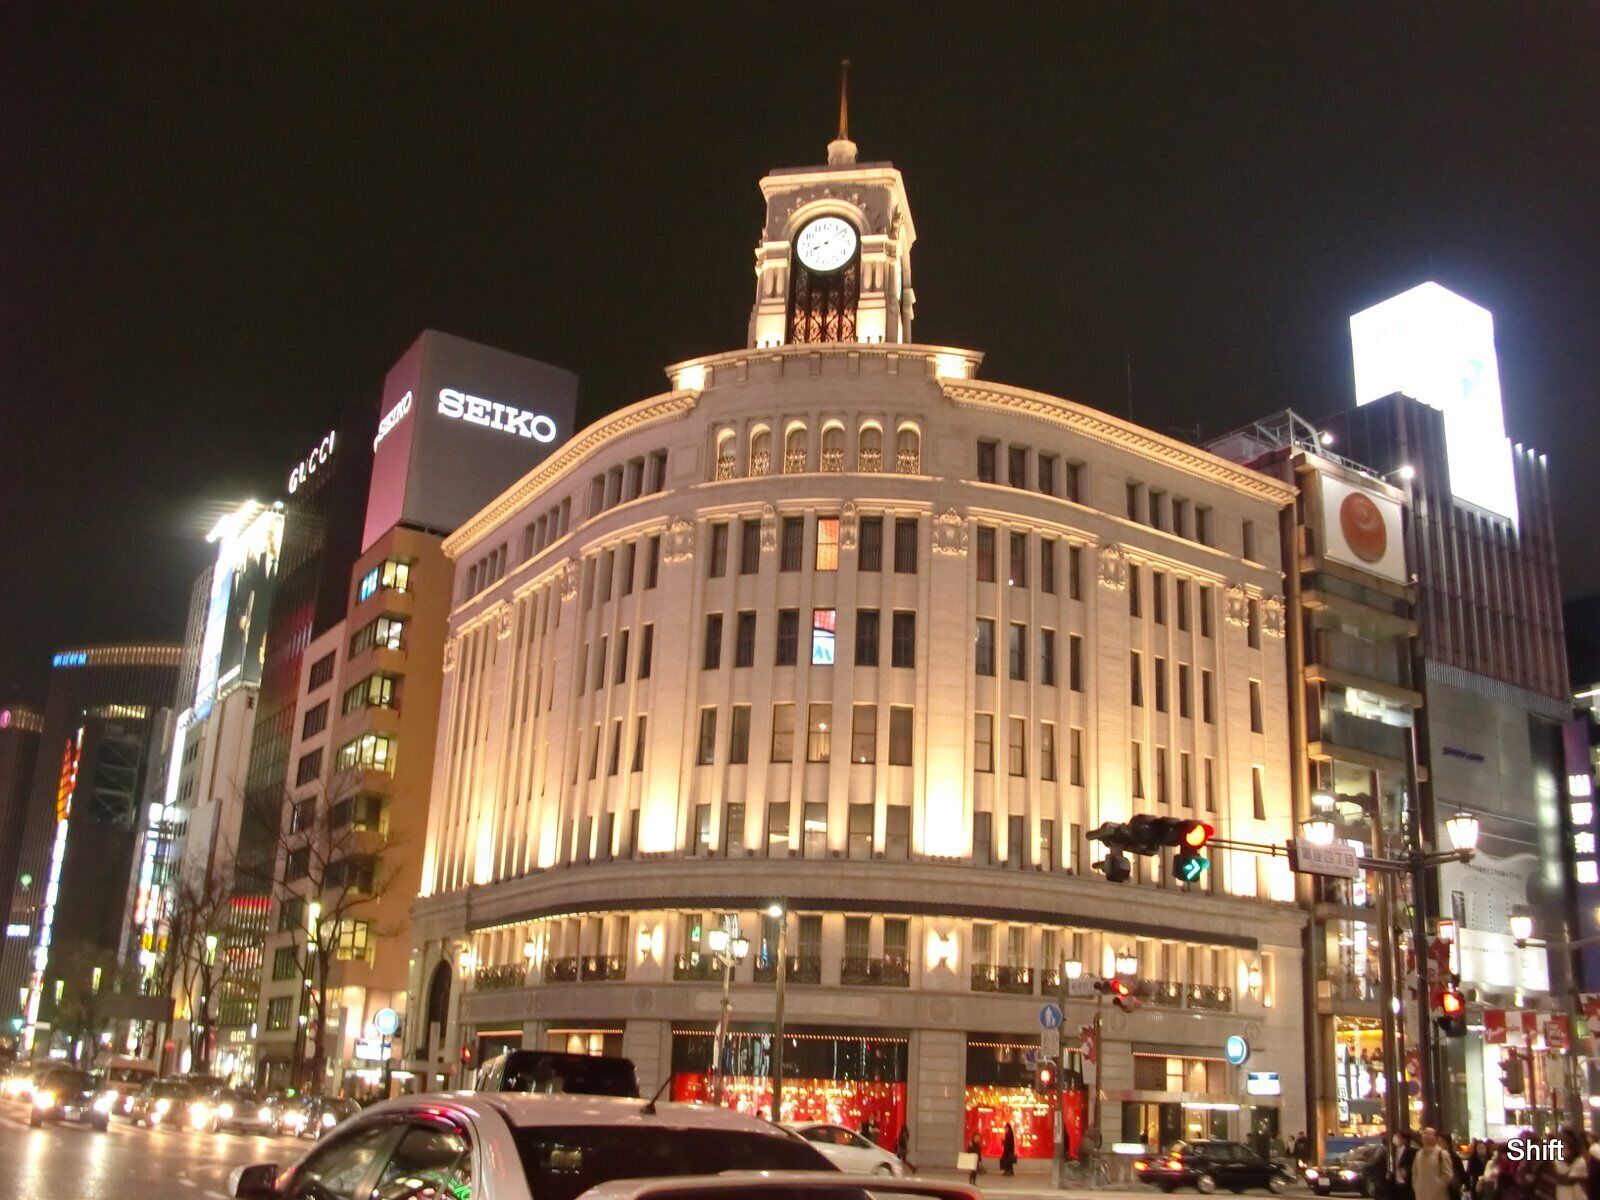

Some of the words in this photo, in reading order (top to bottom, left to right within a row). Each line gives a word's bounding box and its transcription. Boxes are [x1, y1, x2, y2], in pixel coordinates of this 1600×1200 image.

[374, 390, 413, 451] SEIKO
[437, 388, 557, 443] SEIKO
[288, 430, 336, 494] GUCCI
